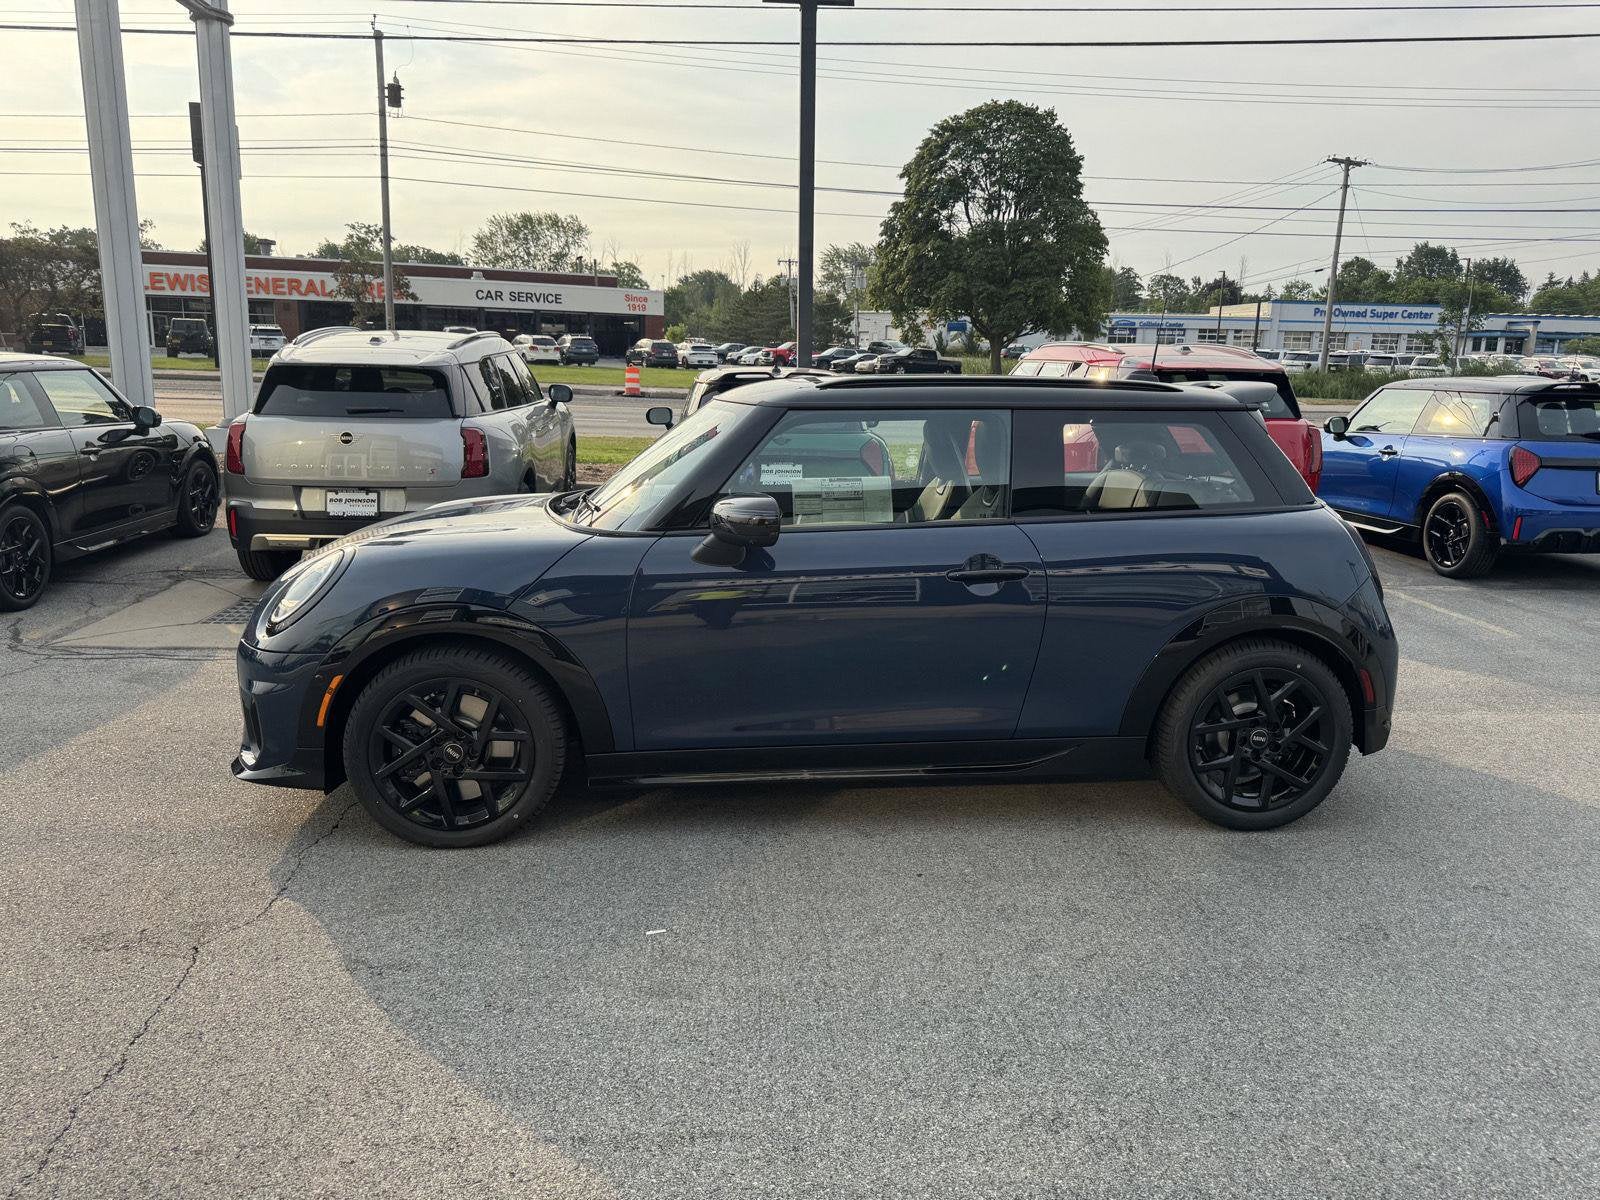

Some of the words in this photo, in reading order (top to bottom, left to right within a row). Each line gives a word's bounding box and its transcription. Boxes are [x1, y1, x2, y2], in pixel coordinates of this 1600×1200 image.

[144, 271, 209, 292] EWIS
[245, 276, 334, 298] ENERAL
[475, 289, 504, 302] CAR
[509, 291, 563, 305] SERVICE
[624, 293, 649, 303] Since
[1369, 308, 1399, 320] Super
[1401, 309, 1434, 320] Center
